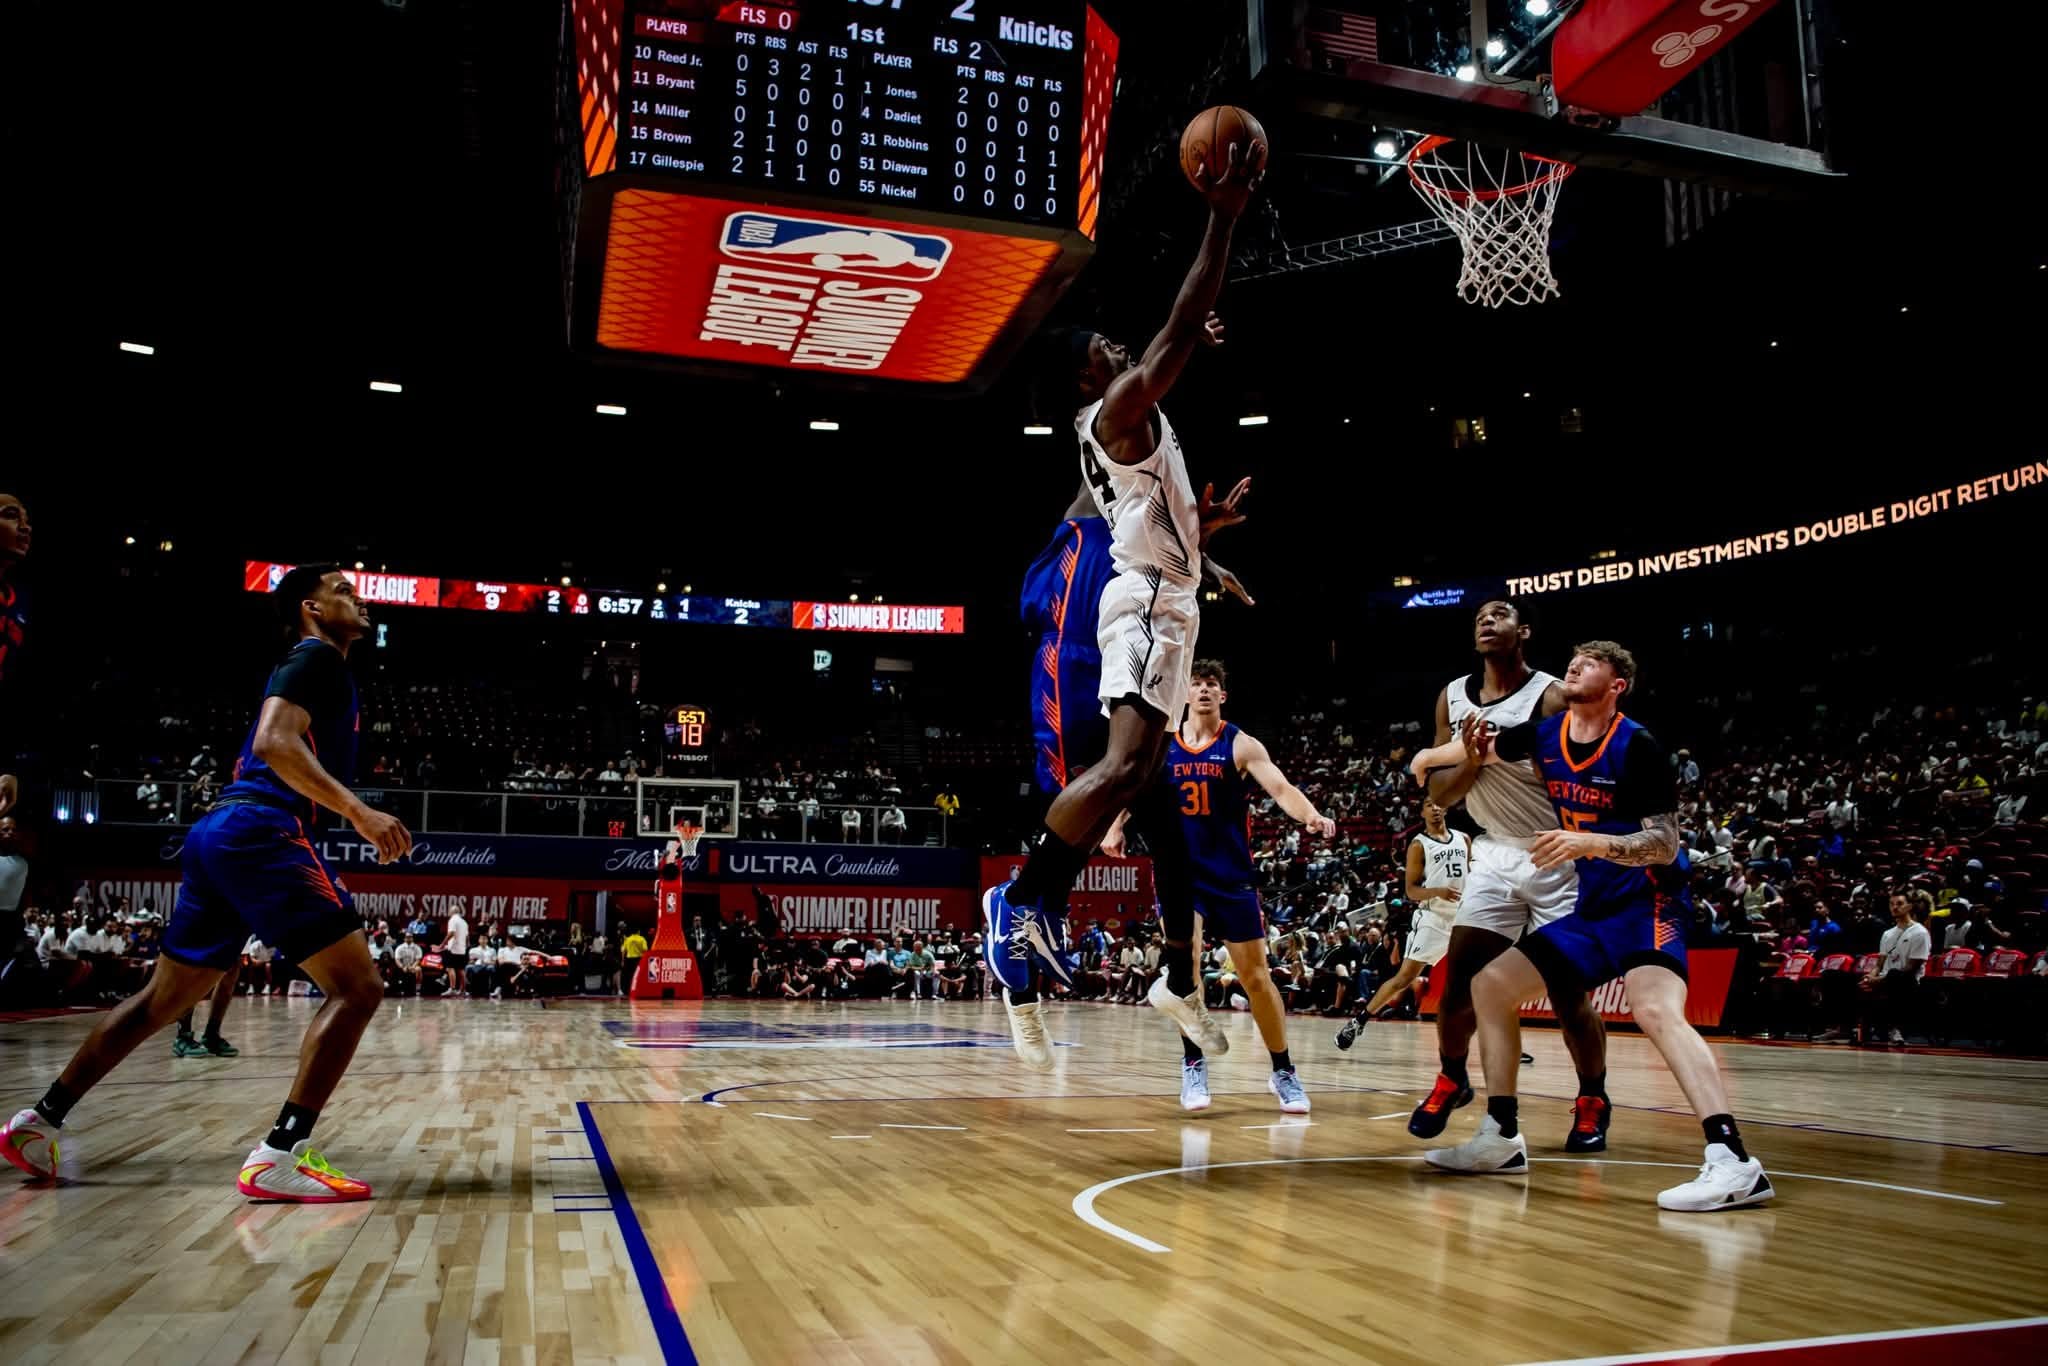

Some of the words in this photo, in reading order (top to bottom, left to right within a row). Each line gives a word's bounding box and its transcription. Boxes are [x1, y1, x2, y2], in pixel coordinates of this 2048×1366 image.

[740, 7, 767, 25] FLS
[778, 12, 792, 30] 0
[646, 18, 688, 36] PLAYER
[735, 31, 756, 45] PTS
[765, 36, 787, 50] RBS
[797, 41, 818, 54] AST
[829, 45, 848, 59] FLS
[847, 22, 885, 45] 1st
[999, 16, 1074, 50] Knicks
[933, 36, 958, 54] FLS
[969, 41, 981, 60] 2
[635, 45, 651, 59] 10
[657, 50, 687, 64] Reed
[689, 55, 703, 67] Jr.
[737, 54, 748, 72] 0
[768, 58, 780, 76] 3
[800, 63, 811, 81] 2
[834, 68, 844, 86] 1
[874, 52, 912, 69] PLAYER
[957, 65, 977, 79] PTS
[984, 70, 1005, 83] RBS
[1015, 75, 1035, 88] AST
[1044, 79, 1062, 92] FLS
[633, 70, 649, 84] 11
[656, 73, 695, 89] Bryant
[736, 79, 747, 97] 5
[767, 83, 778, 101] 0
[799, 88, 810, 105] 0
[832, 92, 844, 110] 0
[864, 81, 872, 95] 1
[885, 84, 918, 100] Jones
[958, 87, 969, 104] 2
[988, 91, 999, 109] 0
[1018, 96, 1029, 113] 0
[1049, 101, 1061, 118] 0
[631, 100, 648, 114] 14
[655, 103, 690, 119] Miller
[734, 105, 746, 123] 0
[767, 109, 776, 127] 1
[798, 114, 809, 132] 0
[831, 118, 843, 136] 0
[861, 106, 870, 119] 4
[884, 108, 922, 125] Dadiet
[957, 111, 968, 129] 0
[987, 115, 998, 132] 0
[1017, 120, 1028, 137] 0
[1048, 125, 1059, 142] 0
[631, 126, 648, 140] 15
[653, 129, 692, 145] Brown
[733, 130, 744, 148] 2
[765, 134, 775, 152] 1
[796, 138, 808, 157] 0
[830, 143, 841, 161] 0
[860, 132, 877, 147] 31
[883, 134, 930, 152] Robbins
[956, 137, 967, 154] 0
[986, 141, 997, 158] 0
[1017, 146, 1026, 163] 1
[1048, 150, 1057, 167] 1
[629, 151, 647, 166] 17
[652, 154, 704, 172] Gillespie
[732, 155, 743, 174] 2
[764, 159, 774, 178] 1
[796, 163, 806, 182] 1
[829, 168, 840, 186] 0
[859, 156, 876, 171] 51
[882, 159, 929, 176] Diawara
[955, 161, 966, 178] 0
[985, 165, 996, 182] 0
[1015, 169, 1026, 186] 0
[1047, 174, 1057, 191] 1
[859, 180, 876, 194] 55
[880, 183, 917, 199] Nickel
[953, 185, 965, 202] 0
[984, 189, 995, 206] 0
[1014, 194, 1025, 211] 0
[1046, 198, 1057, 215] 0
[738, 219, 778, 244] NBA
[699, 264, 821, 351] LEAGUE
[790, 280, 923, 370] SUMMER
[1506, 570, 1573, 597] TRUST
[1577, 562, 1634, 587] DEED
[1638, 529, 1789, 577] INVESTMENTS
[1794, 507, 1886, 546] DOUBLE
[1890, 488, 1952, 523] DIGIT
[358, 575, 418, 603] LEAGUE
[485, 592, 500, 610] 9
[547, 590, 560, 605] 2
[577, 594, 588, 606] 0
[598, 597, 643, 614] 6:57
[653, 600, 663, 610] 2
[680, 598, 689, 612] 1
[725, 598, 761, 609] Knicks
[734, 608, 749, 624] 2
[828, 605, 890, 629] SUMMER
[892, 608, 945, 631] LEAGUE
[682, 724, 702, 746] 18
[1173, 763, 1192, 777] EW
[1179, 781, 1211, 816] 31
[314, 841, 399, 863] LTR
[729, 854, 817, 874] ULTRA
[1088, 866, 1139, 892] LEAGUE
[1445, 863, 1462, 877] 15
[98, 880, 183, 919] SUMM
[472, 896, 508, 919] PLAY
[512, 897, 549, 920] HERE
[781, 896, 868, 933] SUMMER
[872, 897, 942, 935] LEAGUE
